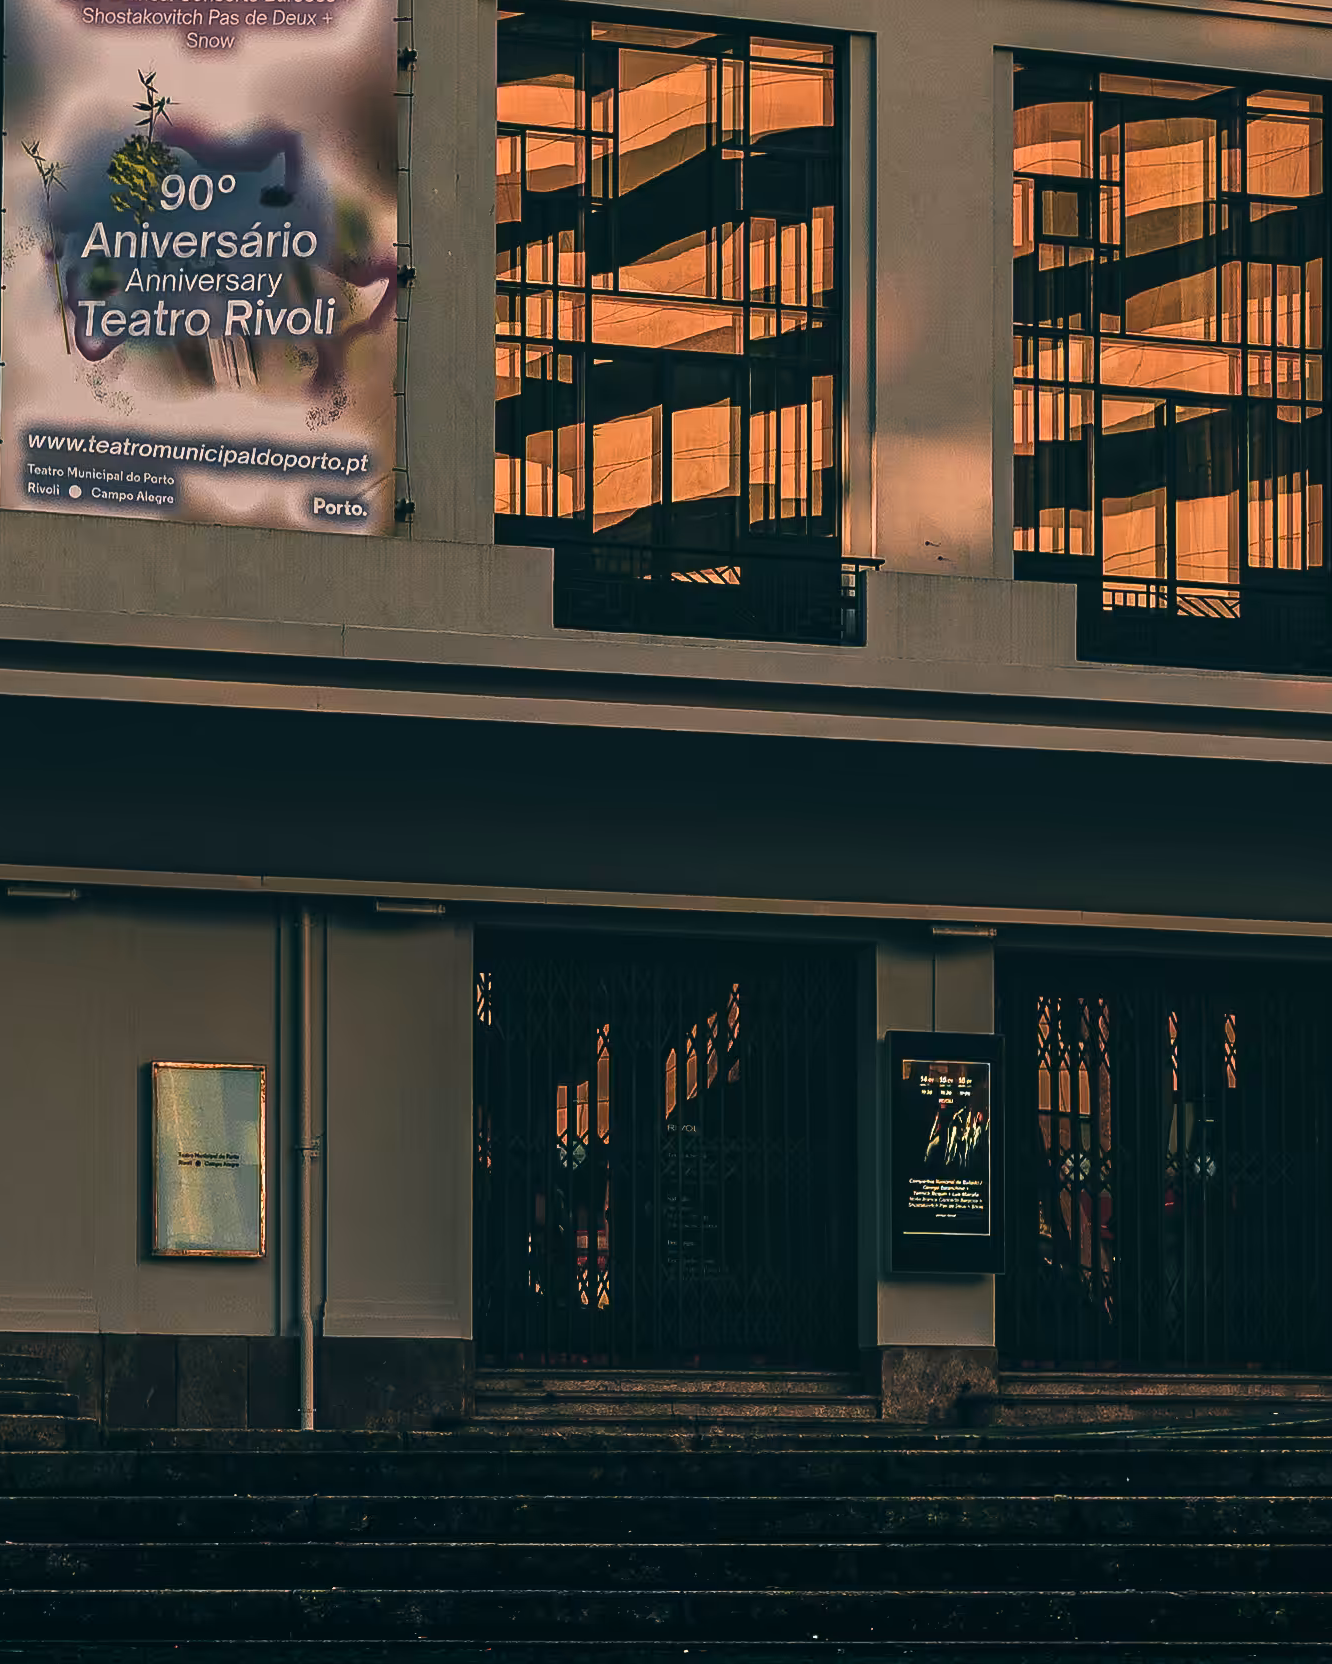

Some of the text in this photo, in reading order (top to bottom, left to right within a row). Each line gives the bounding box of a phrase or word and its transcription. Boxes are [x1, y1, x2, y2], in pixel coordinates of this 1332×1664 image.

[82, 7, 333, 26] Shostakovitch Pas de Deux +
[186, 31, 236, 49] Snow
[80, 221, 318, 259] Aniversário
[124, 267, 283, 298] Anniversary
[77, 297, 336, 338] Teatro Rivoli
[28, 434, 369, 476] www.teatromunicipaldoporto.pt
[26, 462, 175, 486] Teatro Municipal do Porto
[27, 481, 60, 496] Rivoli
[91, 486, 174, 505] Campo Alegre
[313, 497, 368, 517] Porto.
